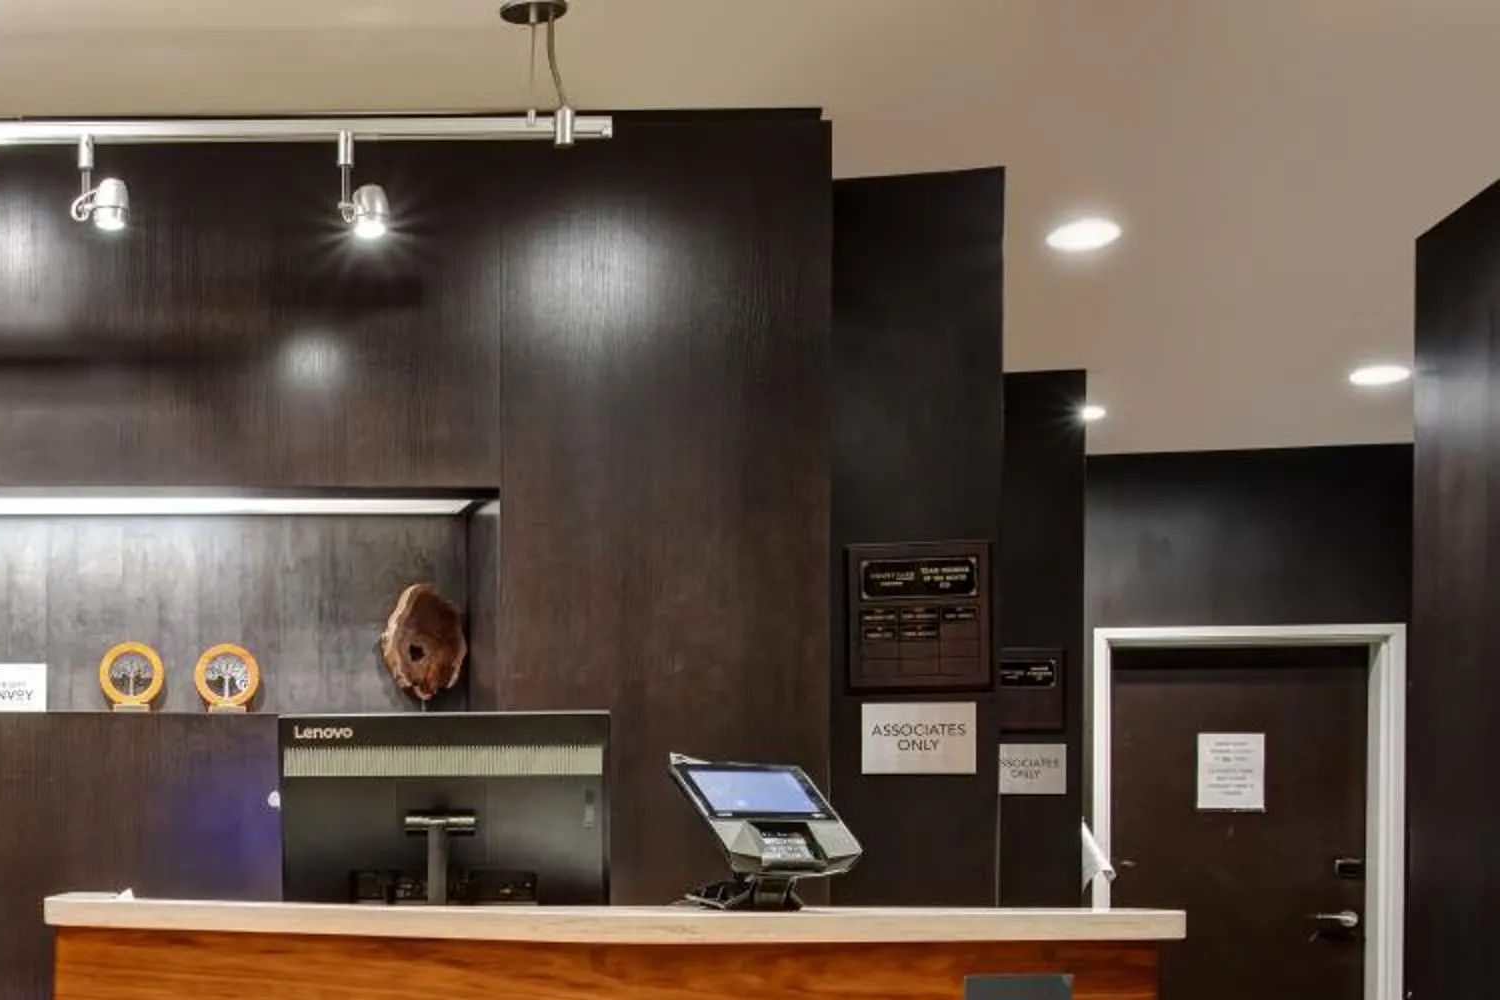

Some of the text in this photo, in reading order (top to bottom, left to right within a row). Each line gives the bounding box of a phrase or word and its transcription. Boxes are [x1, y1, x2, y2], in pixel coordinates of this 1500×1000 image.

[293, 725, 353, 739] Lenovo
[871, 723, 967, 737] ASSOCIATES
[897, 739, 940, 751] ONLY
[1000, 759, 1060, 769] SSOCIATES
